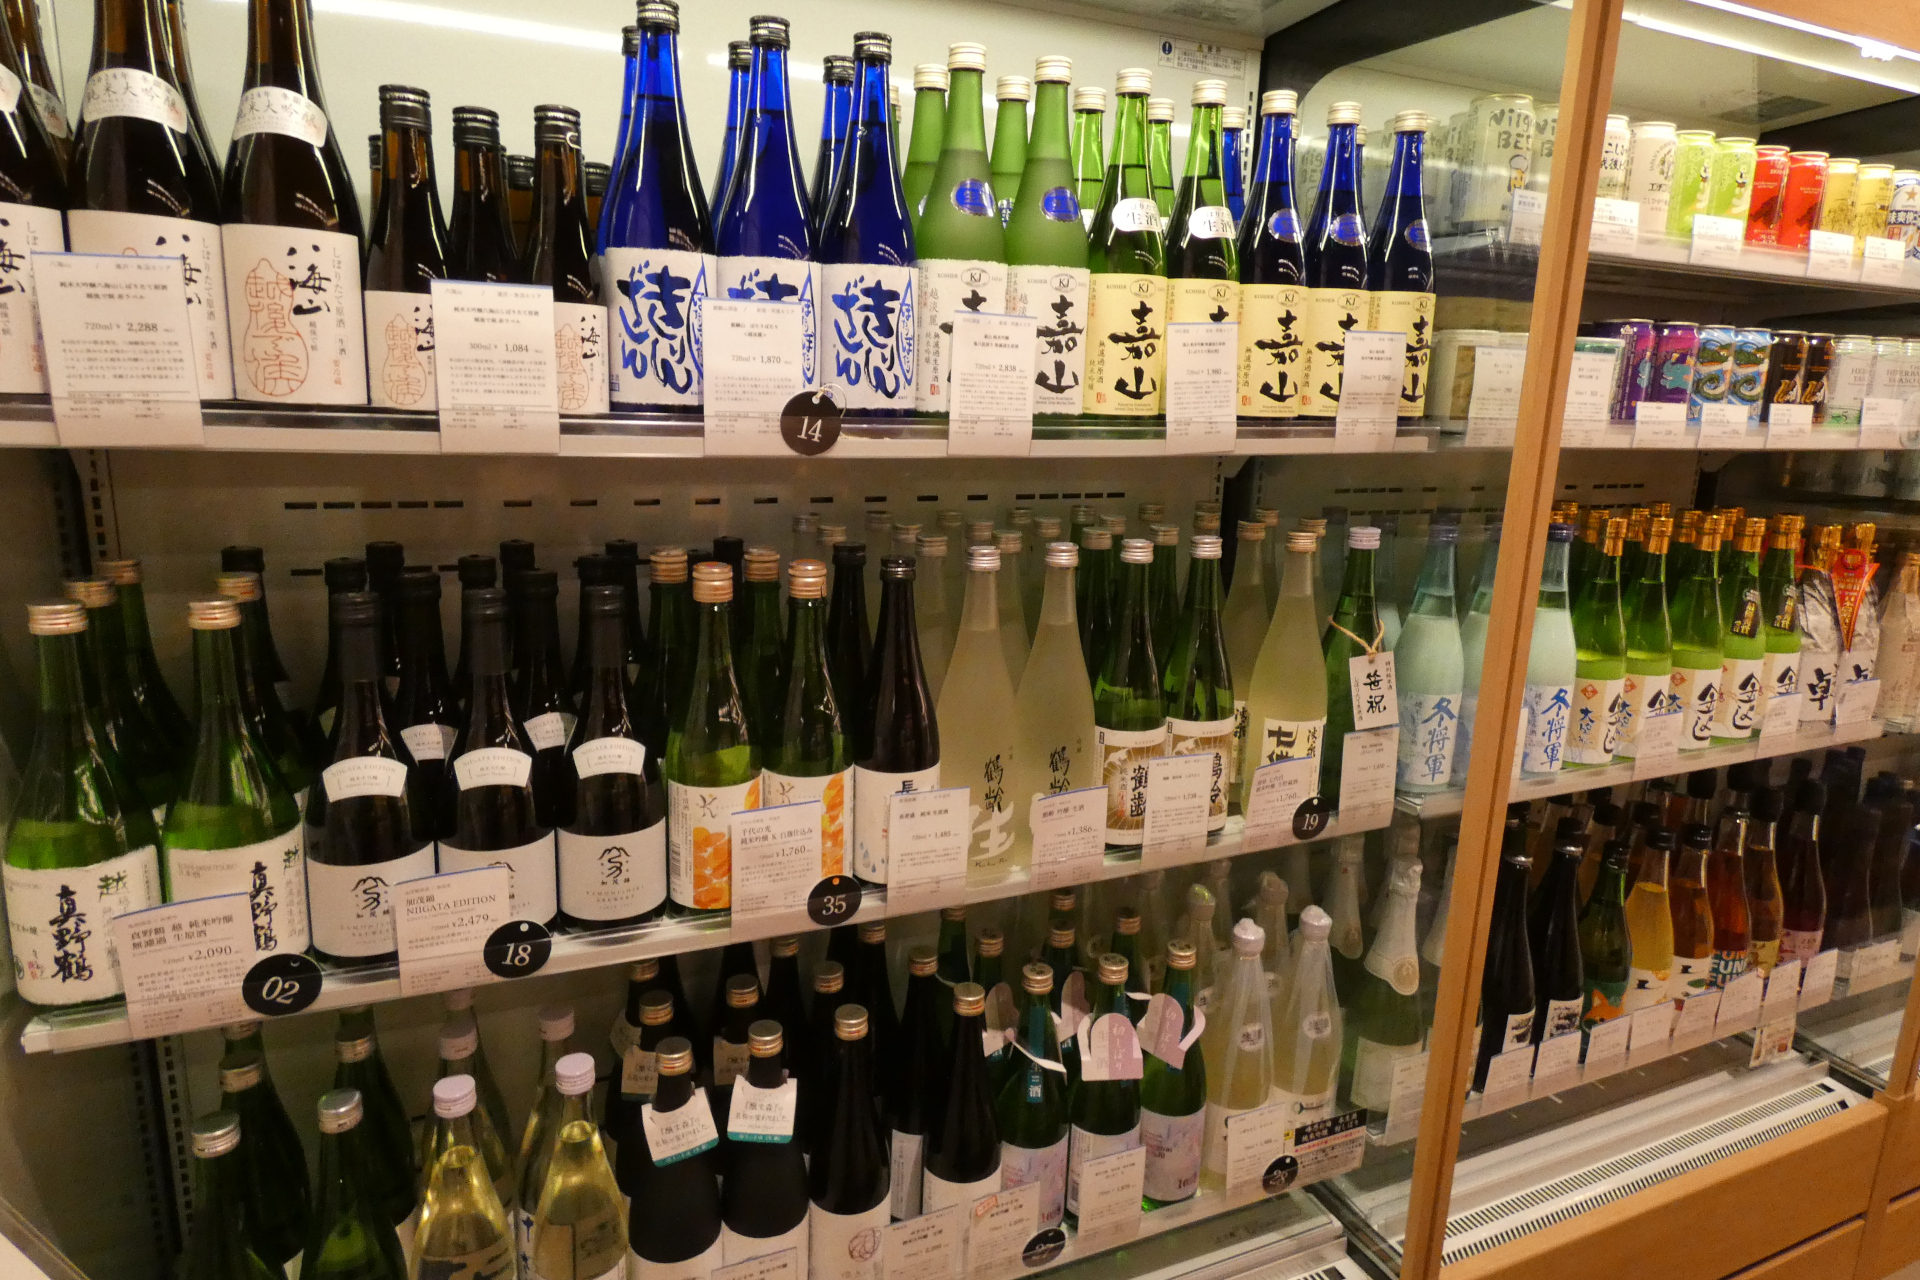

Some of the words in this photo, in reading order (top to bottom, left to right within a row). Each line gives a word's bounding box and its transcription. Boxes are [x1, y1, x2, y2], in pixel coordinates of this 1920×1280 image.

[287, 243, 333, 317] 八海山
[969, 272, 983, 284] KJ
[1058, 278, 1071, 289] KJ
[1138, 283, 1150, 294] KJ
[1215, 287, 1227, 298] KJ
[1284, 292, 1296, 303] KJ
[1345, 296, 1357, 307] KJ
[127, 322, 159, 334] 2,288
[504, 344, 530, 355] 1,084
[1035, 293, 1086, 395] 嘉山
[1107, 300, 1164, 401] 嘉山
[760, 354, 782, 366] 1,870
[1253, 309, 1304, 403] 嘉山
[998, 363, 1017, 373] 2,838
[797, 416, 824, 445] 14
[1362, 668, 1388, 714] 笹祝
[1540, 686, 1572, 770] 冬将軍
[1420, 696, 1458, 784] 冬将軍
[741, 825, 772, 839] 千代の光
[1301, 813, 1320, 831] 19
[406, 902, 452, 918] NIIGATA
[453, 894, 498, 910] EDITION
[821, 893, 847, 917] 35
[501, 942, 532, 967] 18
[262, 976, 301, 1005] 02
